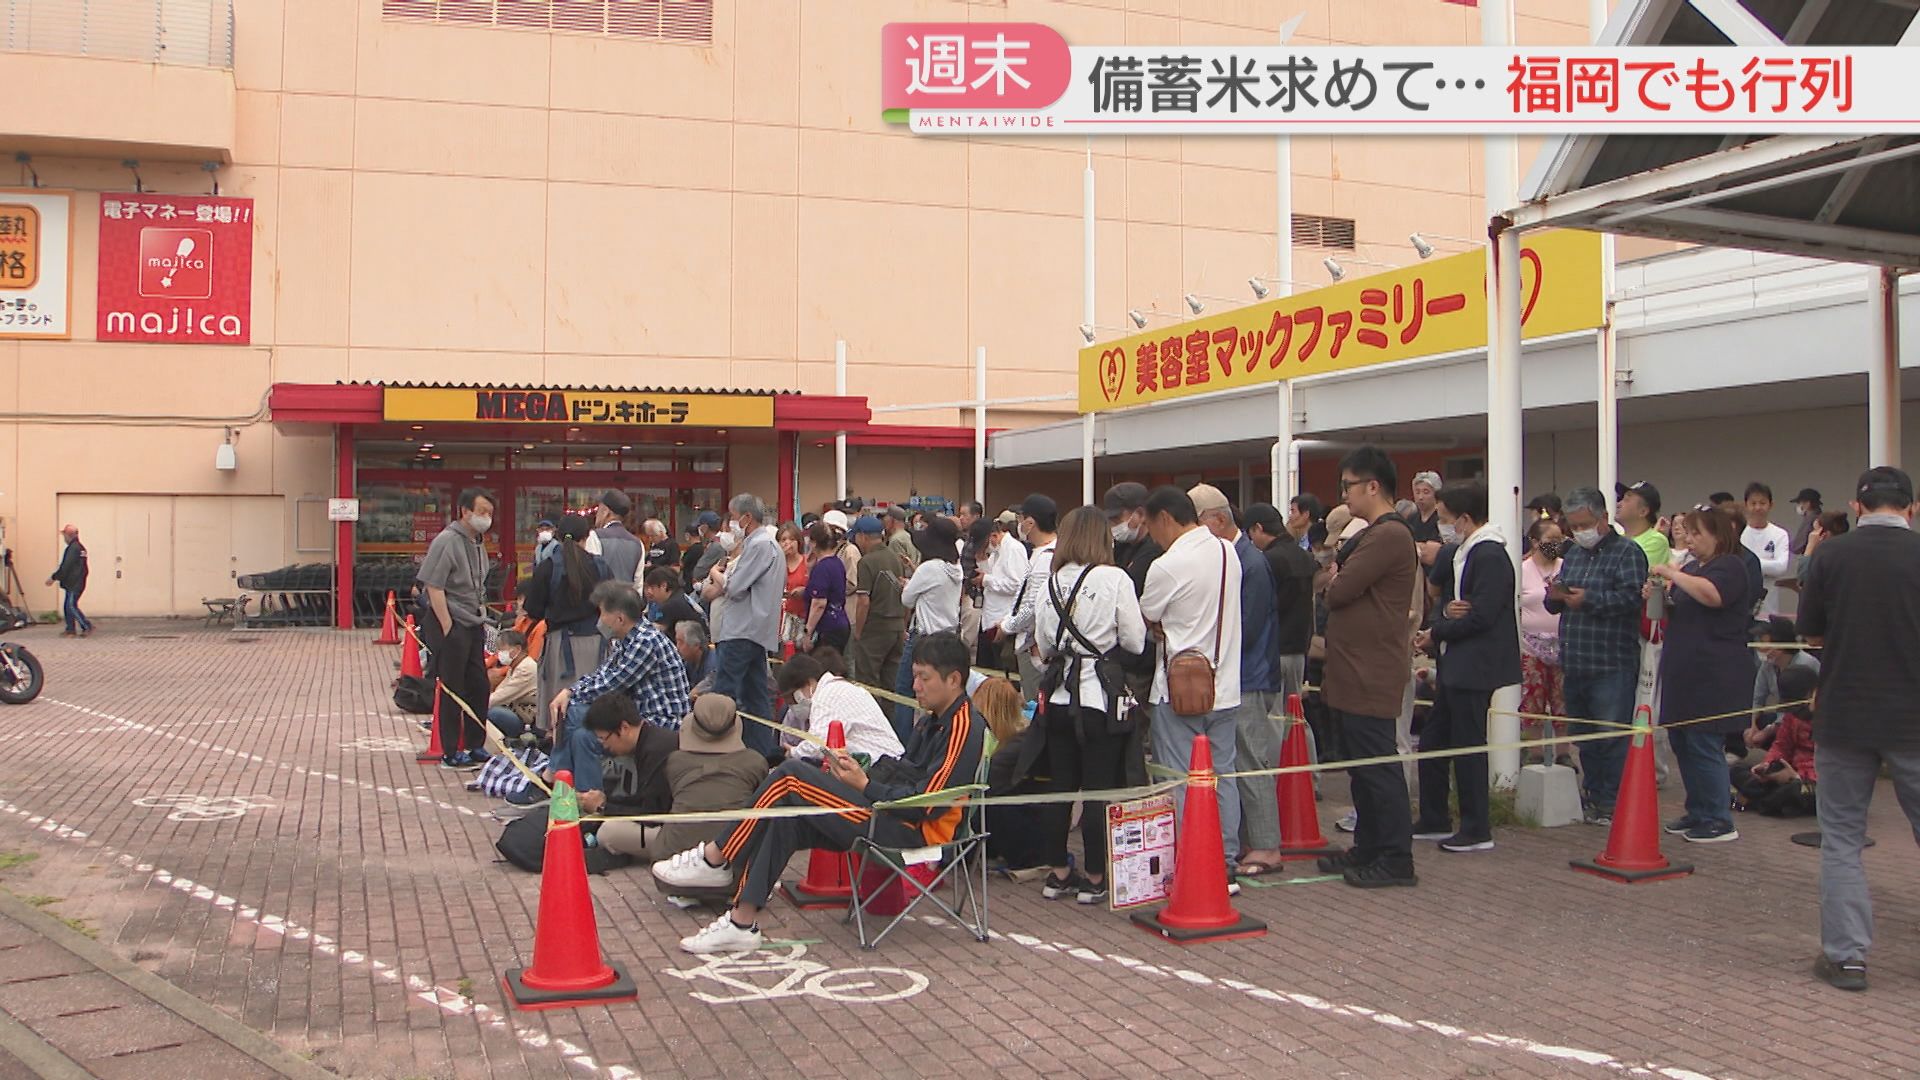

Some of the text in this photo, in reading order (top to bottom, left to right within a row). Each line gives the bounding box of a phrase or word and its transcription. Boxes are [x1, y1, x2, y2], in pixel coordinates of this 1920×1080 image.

[1135, 278, 1467, 396] 美容室マックファミリー
[476, 392, 569, 421] MEGA
